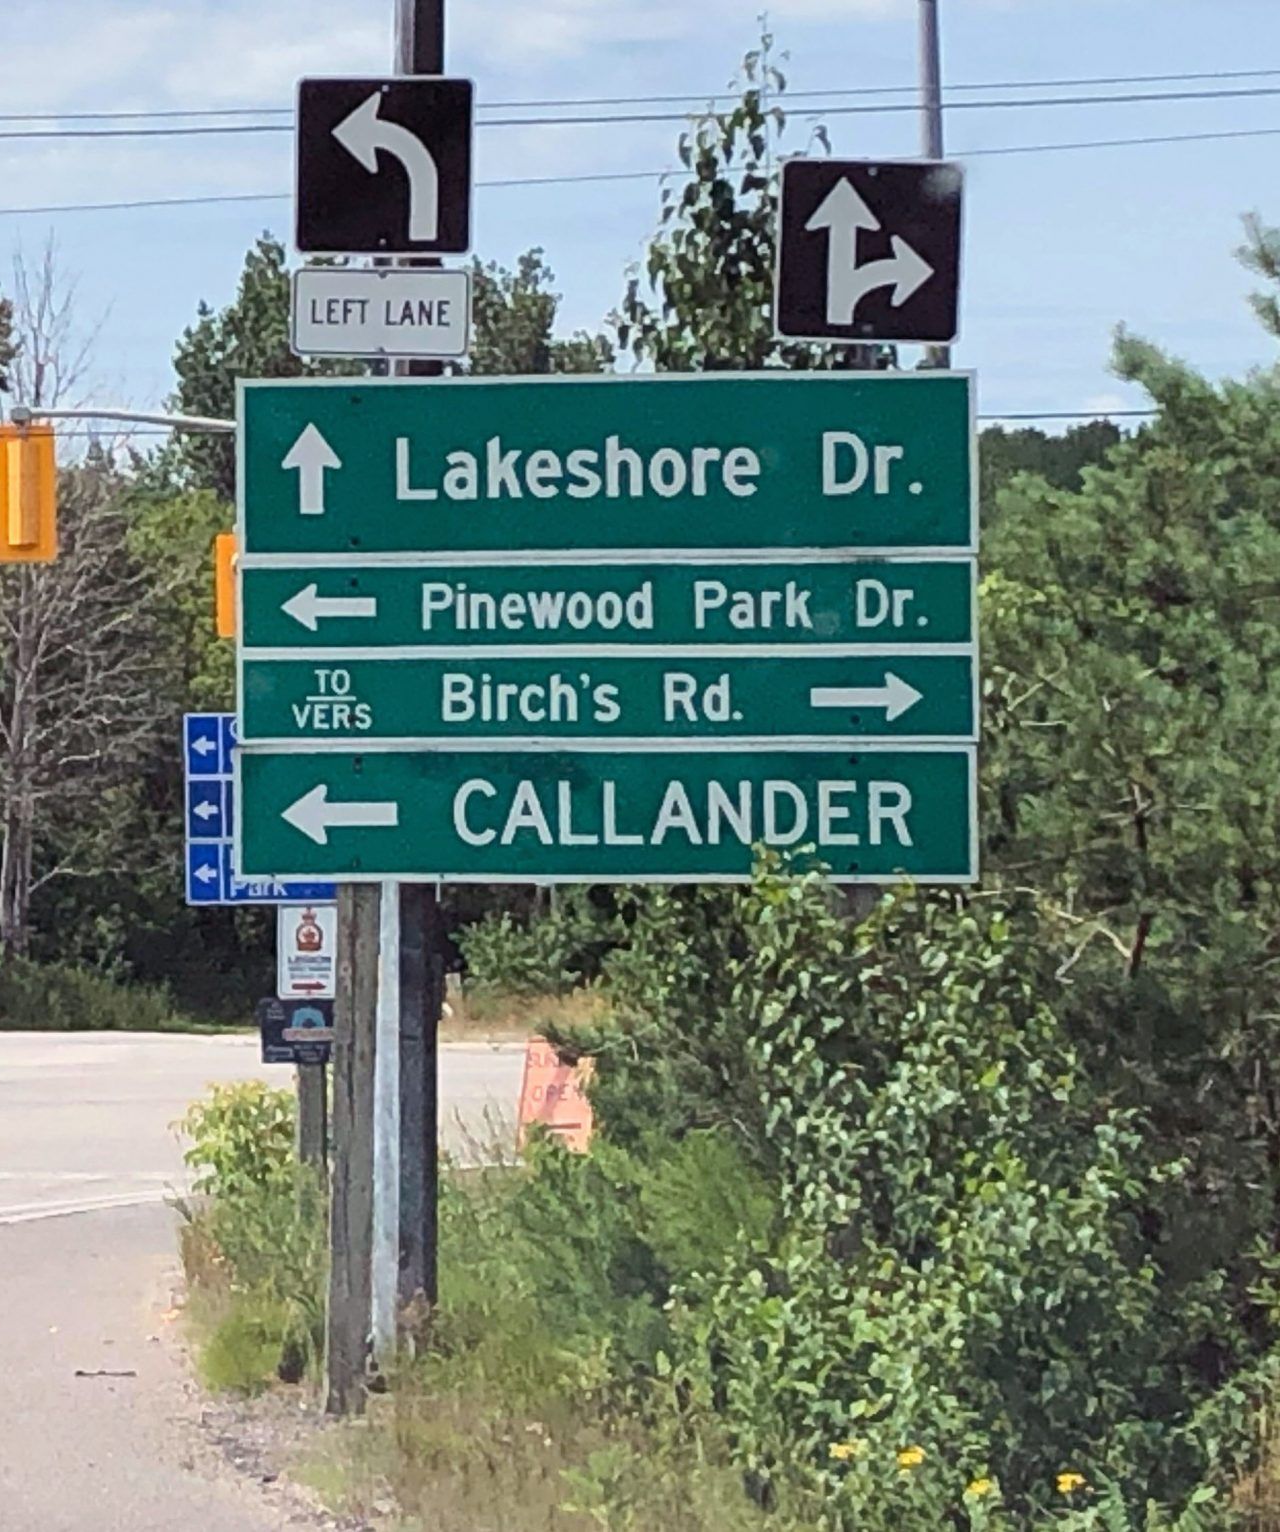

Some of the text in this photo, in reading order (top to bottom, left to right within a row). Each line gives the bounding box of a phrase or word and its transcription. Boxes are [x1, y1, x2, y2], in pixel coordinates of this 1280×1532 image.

[311, 298, 451, 327] LEFT LANE
[395, 431, 923, 500] Lakeshore Dr.
[421, 577, 928, 631] Pinewood Park Dr.
[314, 669, 351, 694] TO
[441, 671, 744, 723] Birch's Rd.
[291, 703, 373, 730] VERS
[452, 777, 914, 847] CALLANDER
[230, 876, 288, 897] Park
